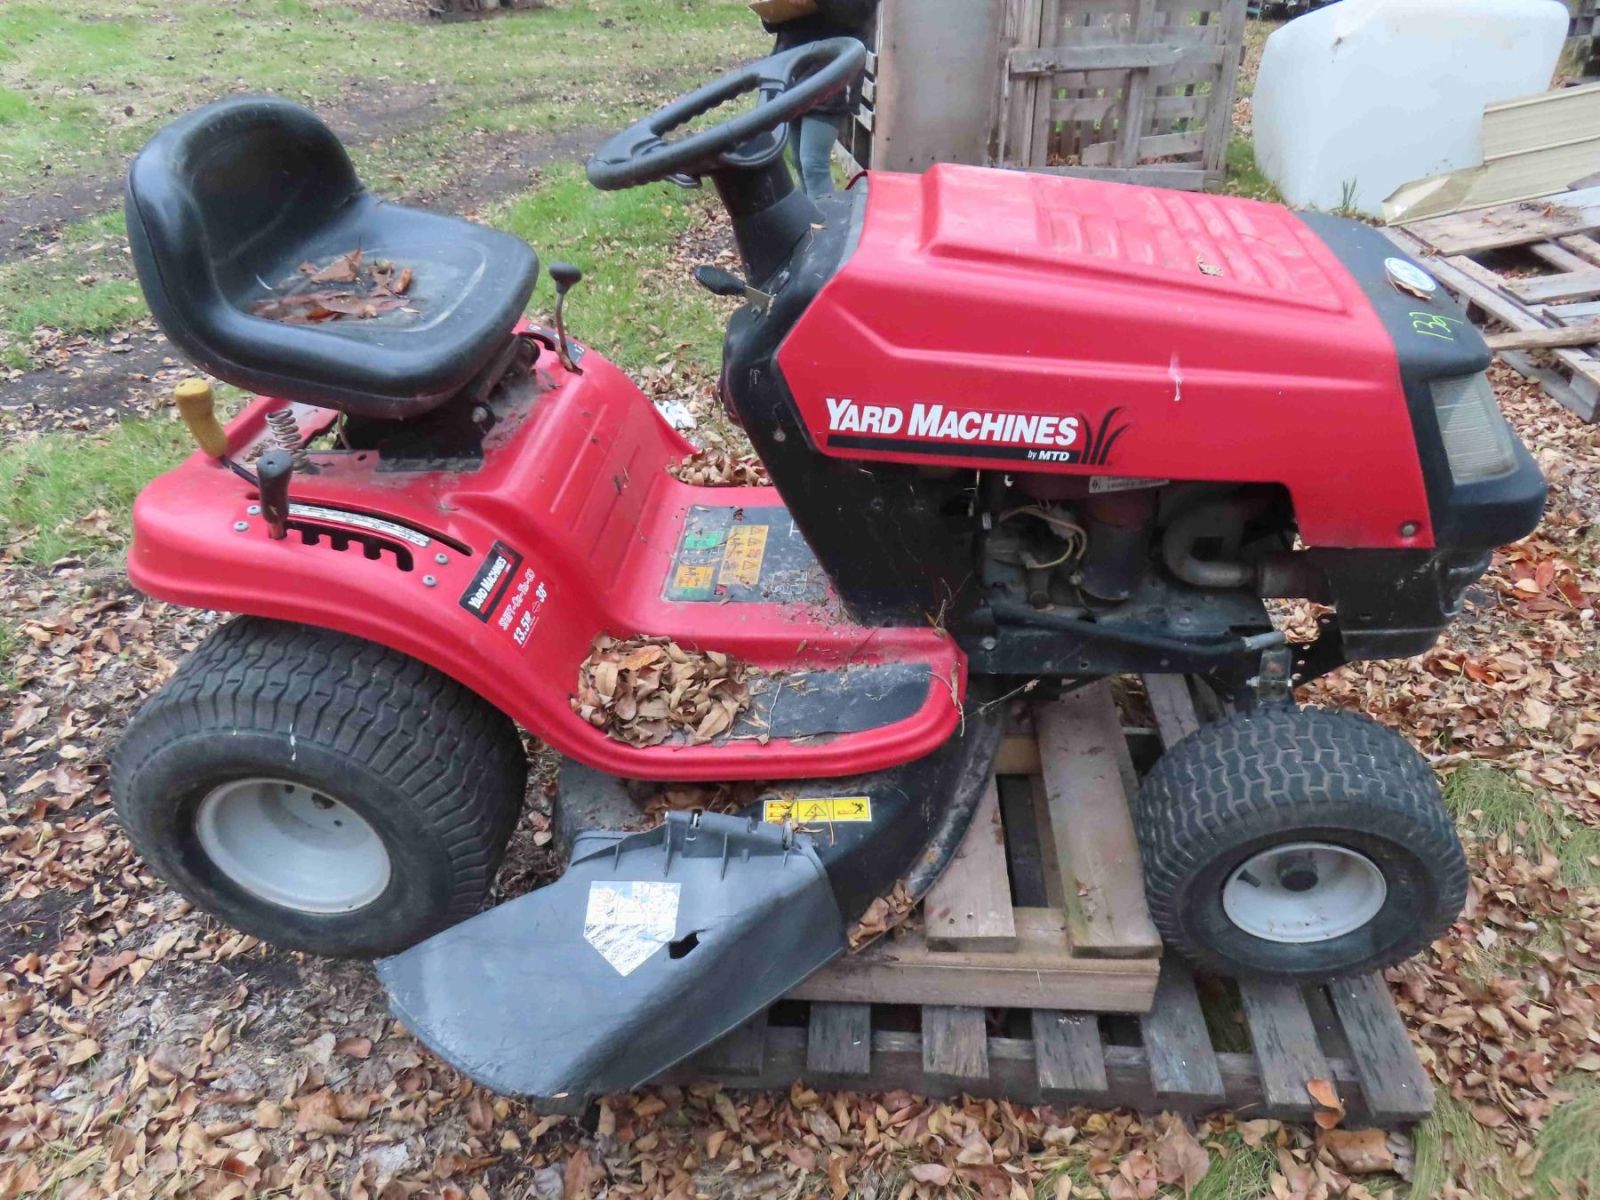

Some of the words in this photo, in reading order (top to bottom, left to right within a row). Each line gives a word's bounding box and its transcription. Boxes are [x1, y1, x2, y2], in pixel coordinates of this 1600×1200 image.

[826, 398, 903, 433] YARD
[907, 404, 1079, 446] MACHINES
[1027, 449, 1037, 460] by
[1039, 450, 1070, 461] MTD
[468, 589, 489, 609] YARD
[480, 556, 507, 592] MACHINES
